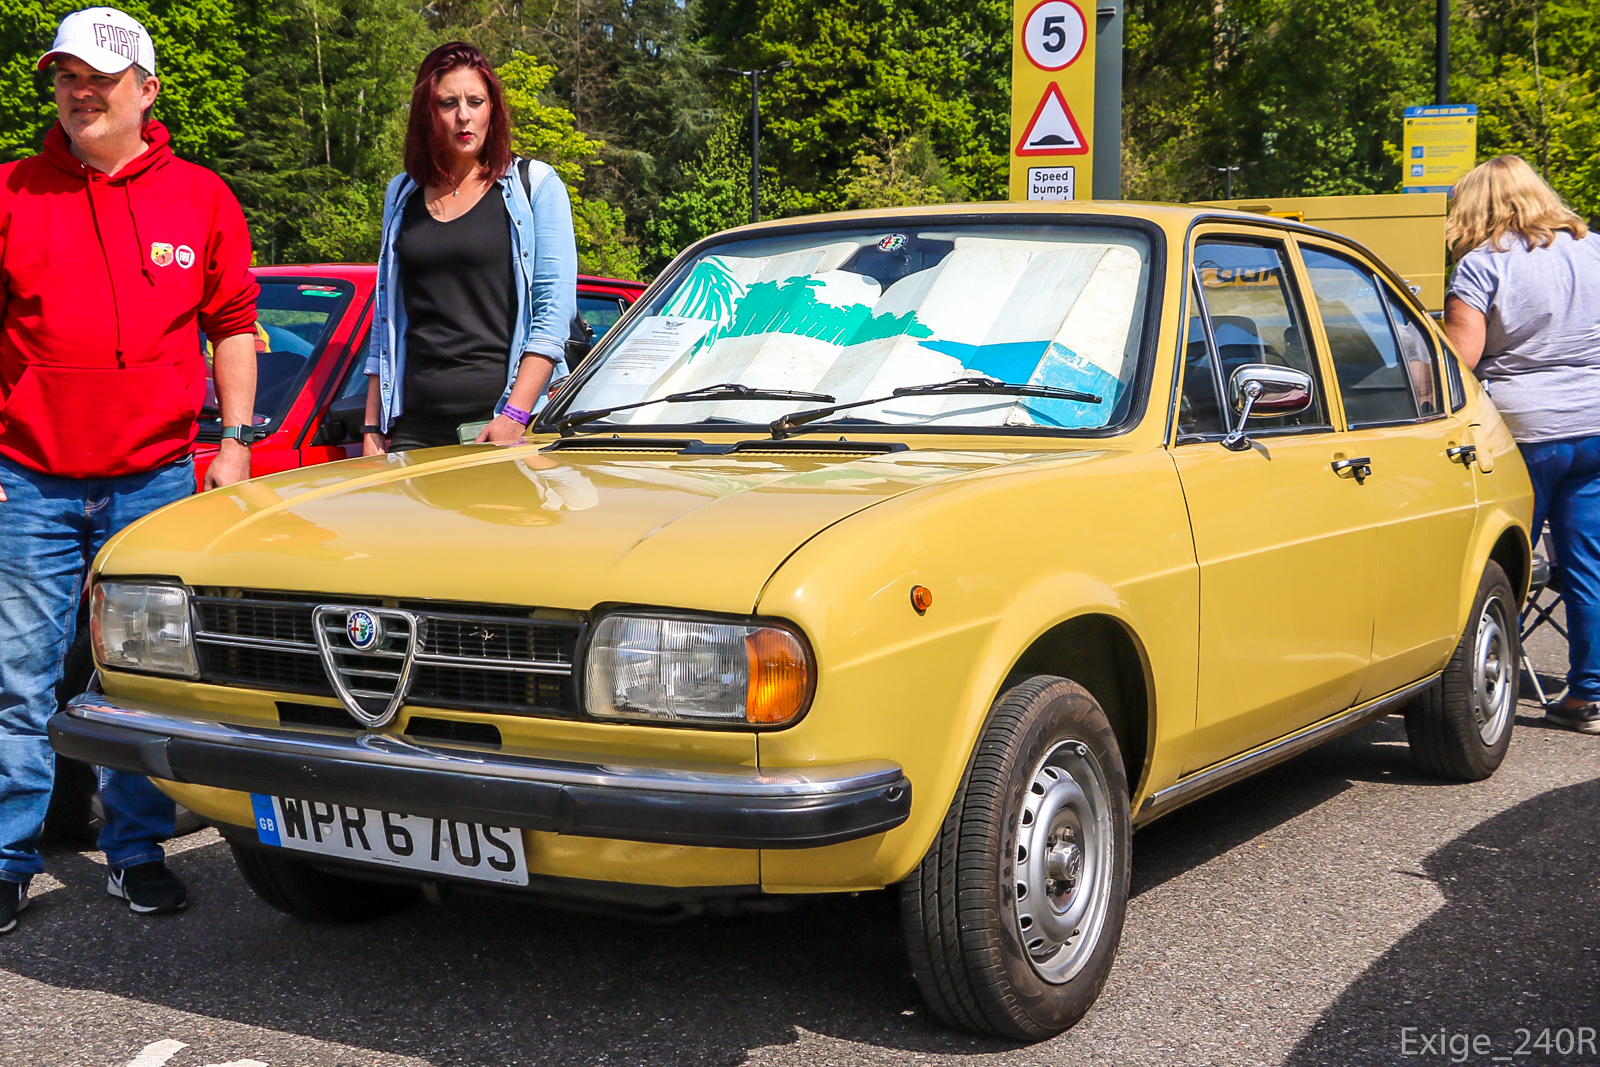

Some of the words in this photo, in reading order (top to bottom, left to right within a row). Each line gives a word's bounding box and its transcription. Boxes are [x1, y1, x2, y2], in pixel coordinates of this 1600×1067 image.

[93, 23, 140, 63] FIAT
[1043, 15, 1066, 53] 5
[1033, 184, 1069, 195] bumps
[1034, 170, 1068, 183] Speed
[259, 817, 275, 832] GB
[278, 797, 372, 851] WPR
